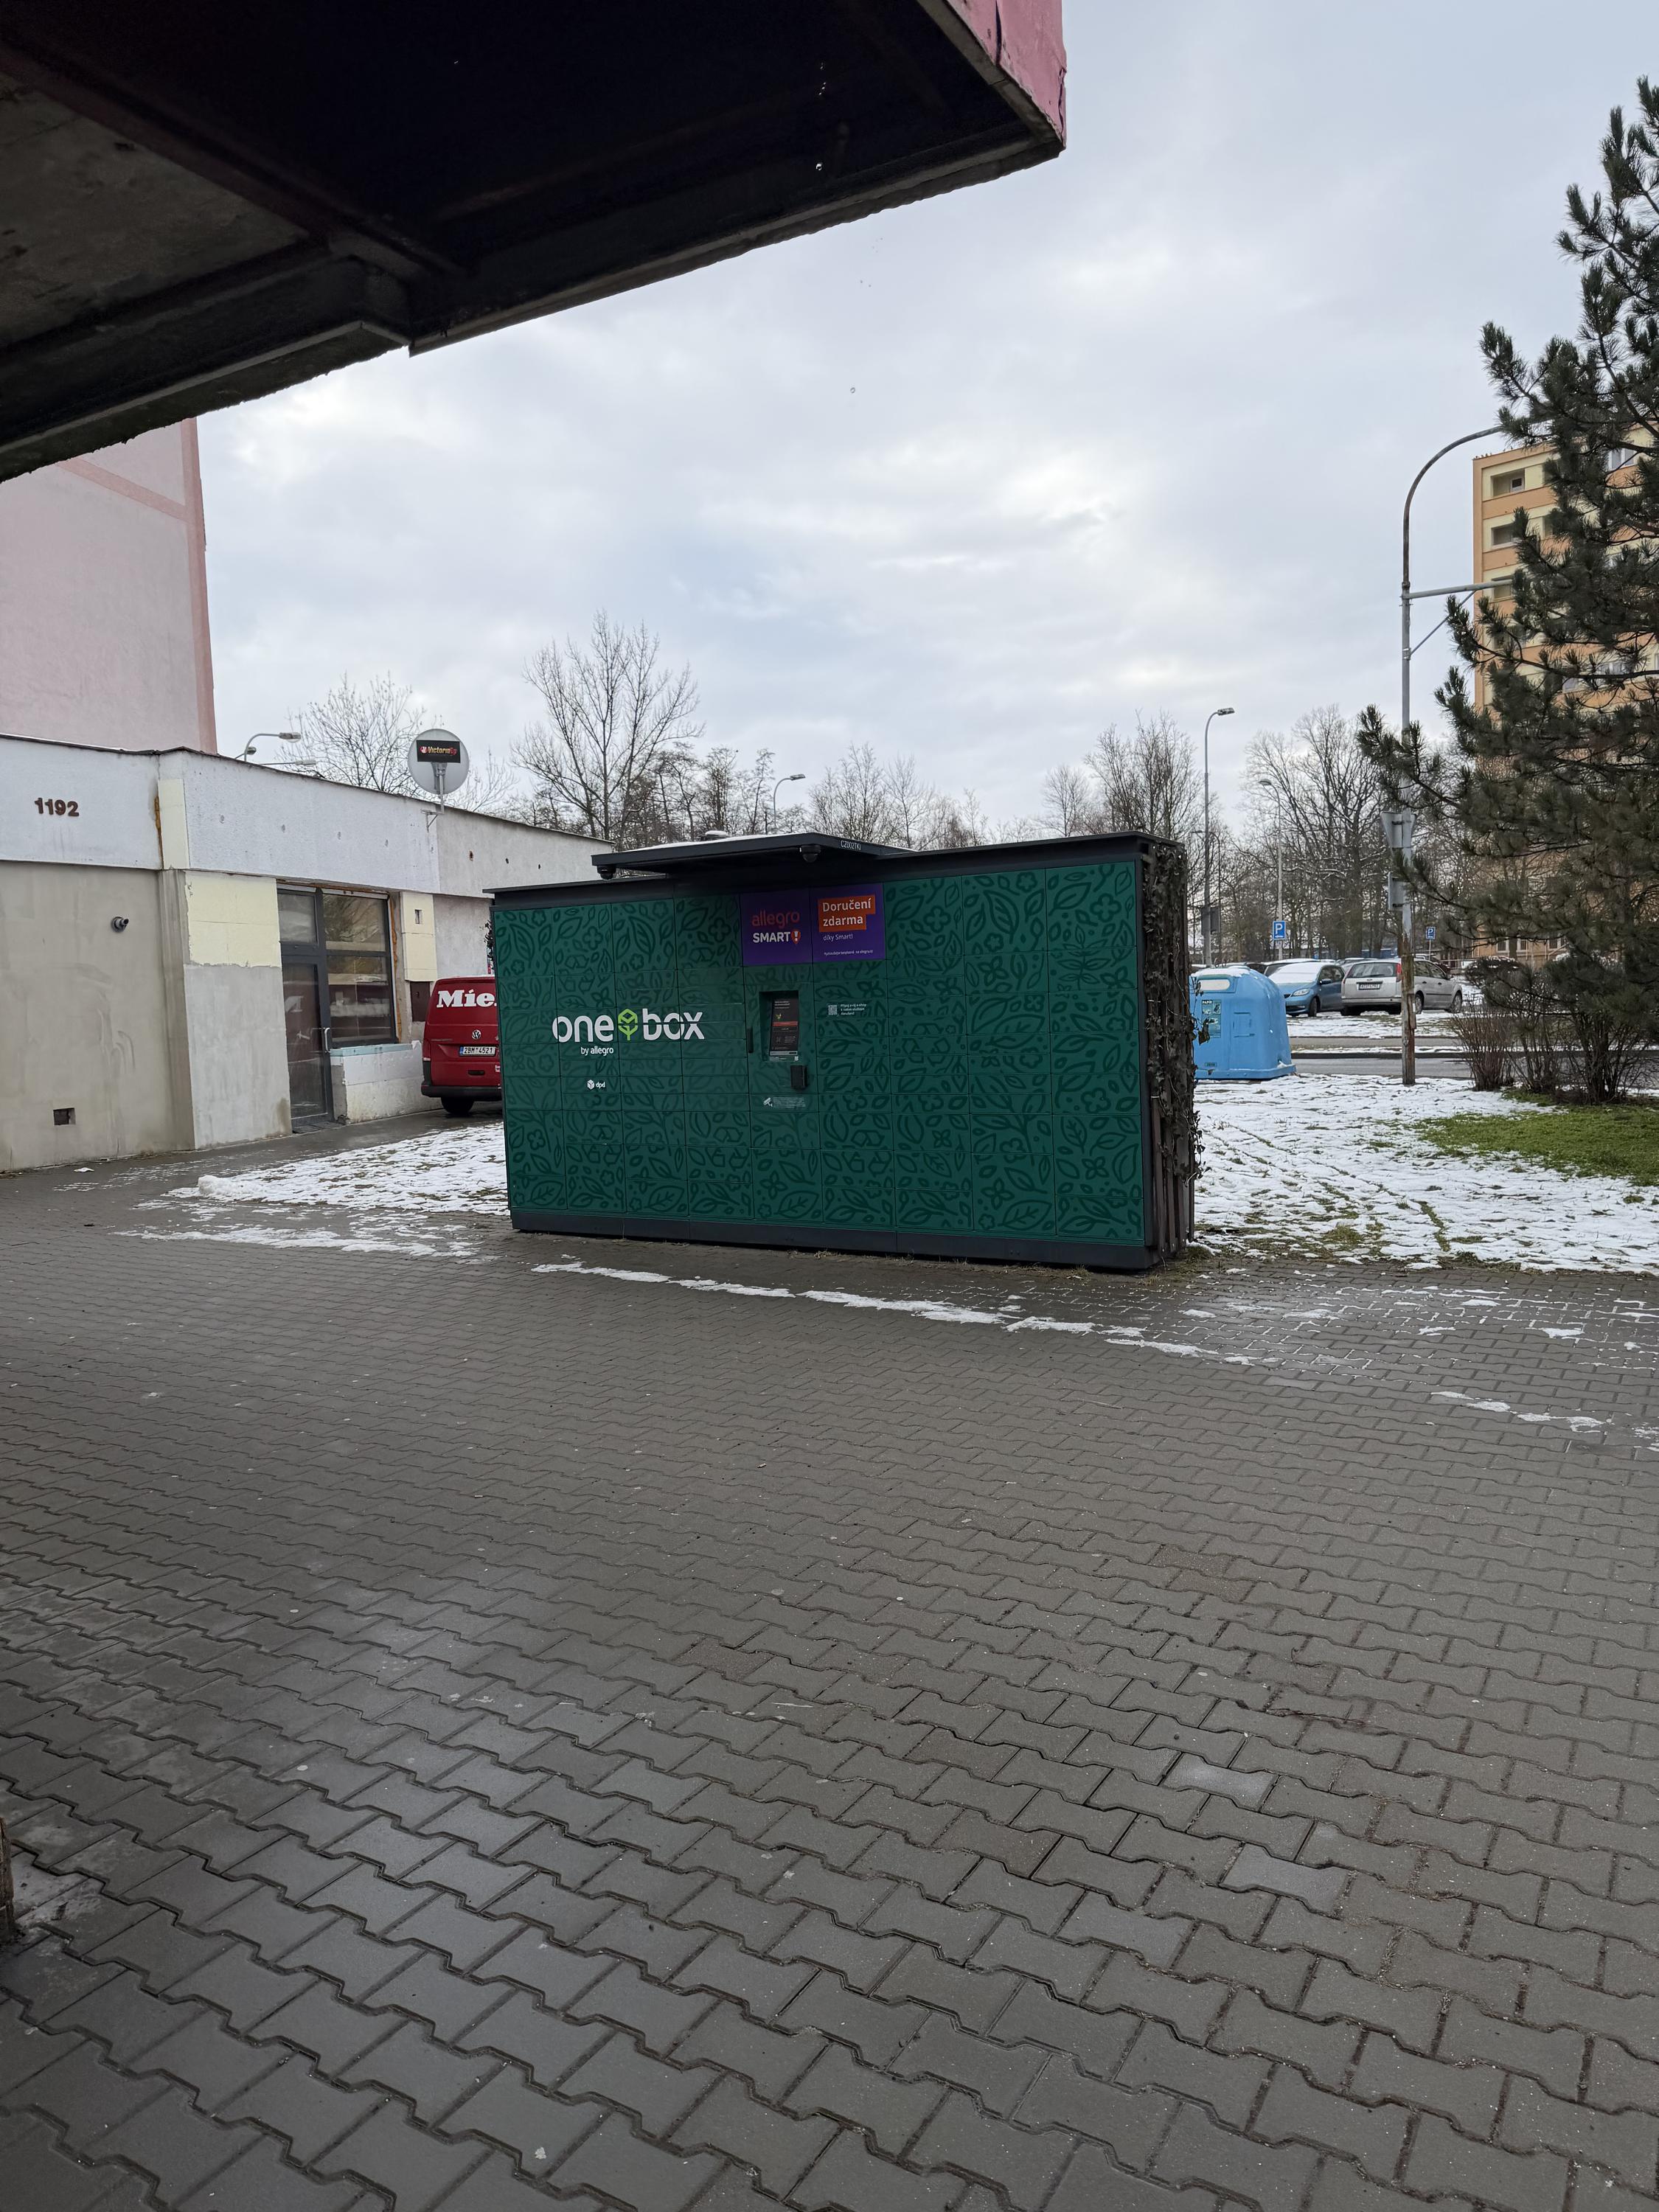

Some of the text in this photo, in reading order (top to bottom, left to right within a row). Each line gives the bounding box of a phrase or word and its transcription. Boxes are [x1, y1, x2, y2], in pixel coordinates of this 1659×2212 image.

[34, 797, 80, 817] 1192
[822, 897, 872, 913] Doručení
[751, 909, 801, 929] allegro
[823, 915, 863, 927] zdarma
[823, 934, 834, 942] díky
[437, 989, 497, 1008] Mie
[580, 1046, 613, 1057] by allegro
[595, 1081, 605, 1089] dpd
